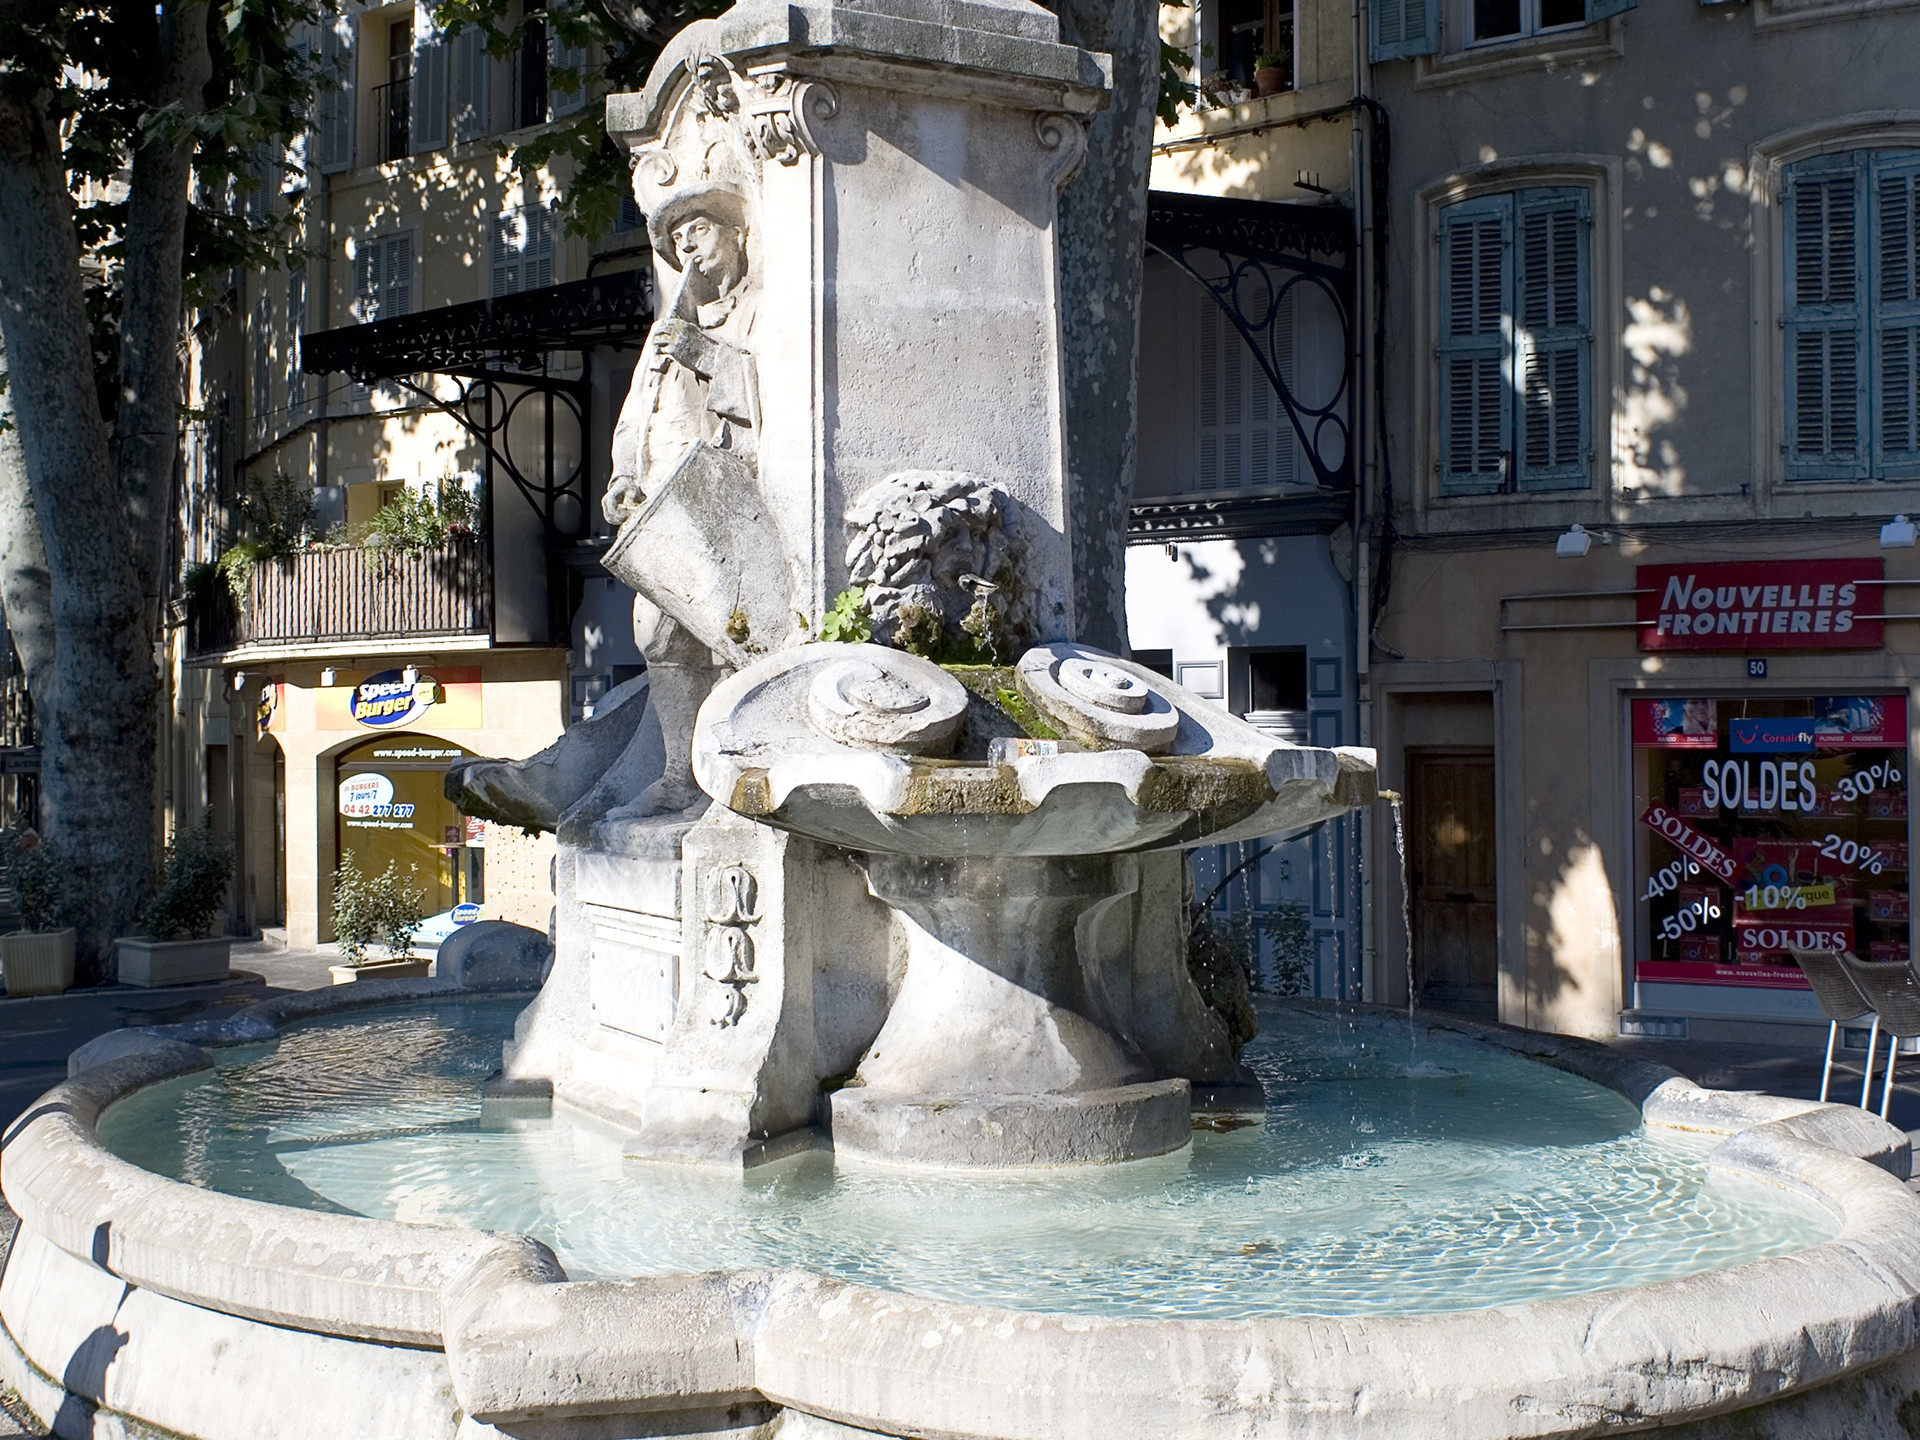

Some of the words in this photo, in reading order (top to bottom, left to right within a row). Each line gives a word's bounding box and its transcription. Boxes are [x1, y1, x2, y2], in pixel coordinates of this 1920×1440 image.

[1661, 575, 1856, 610] NOUVELLES
[1657, 610, 1853, 635] FRONTIERES
[1750, 661, 1764, 674] 50
[359, 682, 414, 701] Speed
[356, 695, 413, 720] Burger
[373, 747, 462, 759] www.speed-burger.com
[350, 782, 379, 791] BURGERS
[1702, 760, 1816, 811] SOLDES
[1831, 760, 1900, 801] -30%
[344, 804, 355, 814] 04
[358, 804, 370, 814] 42
[373, 805, 391, 815] 277
[394, 805, 413, 815] 277
[346, 820, 413, 829] www.speed-burger.com
[1648, 807, 1737, 877] SOLDES
[1812, 834, 1882, 875] -20%
[1640, 854, 1700, 901] -40%
[1734, 885, 1806, 909] -10%
[1657, 896, 1721, 940] -50%
[1743, 928, 1847, 951] SOLDES
